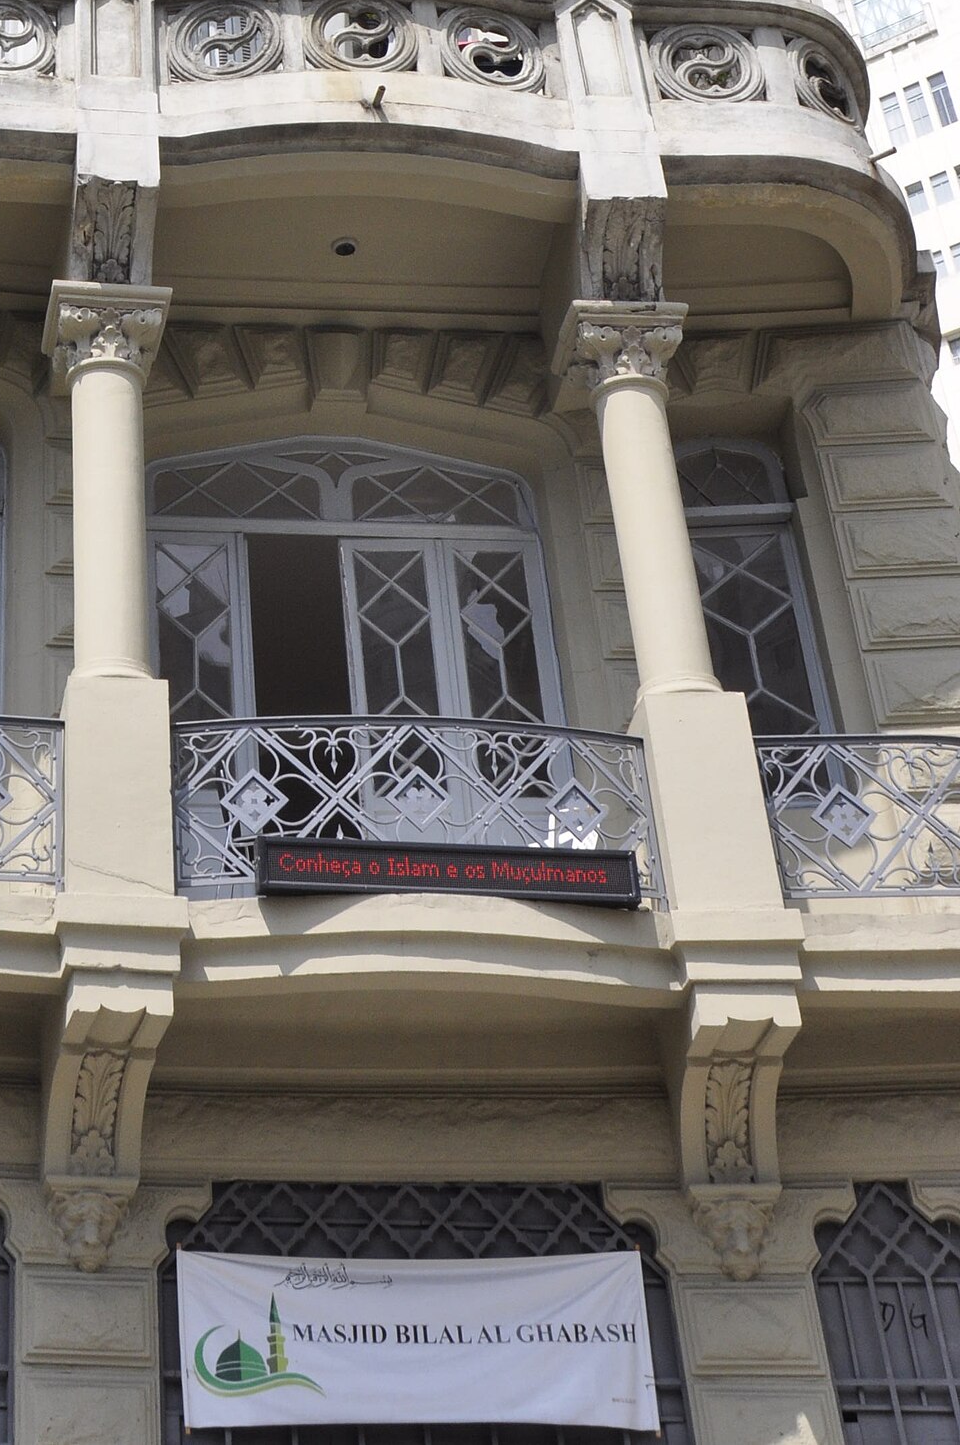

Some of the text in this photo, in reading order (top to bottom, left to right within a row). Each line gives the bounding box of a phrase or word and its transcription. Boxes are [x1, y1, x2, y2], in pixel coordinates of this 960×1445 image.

[279, 852, 608, 884] Conheça o Islam e os Muçulmanos
[292, 1322, 638, 1345] MASJID BILAL AL GHABASH
